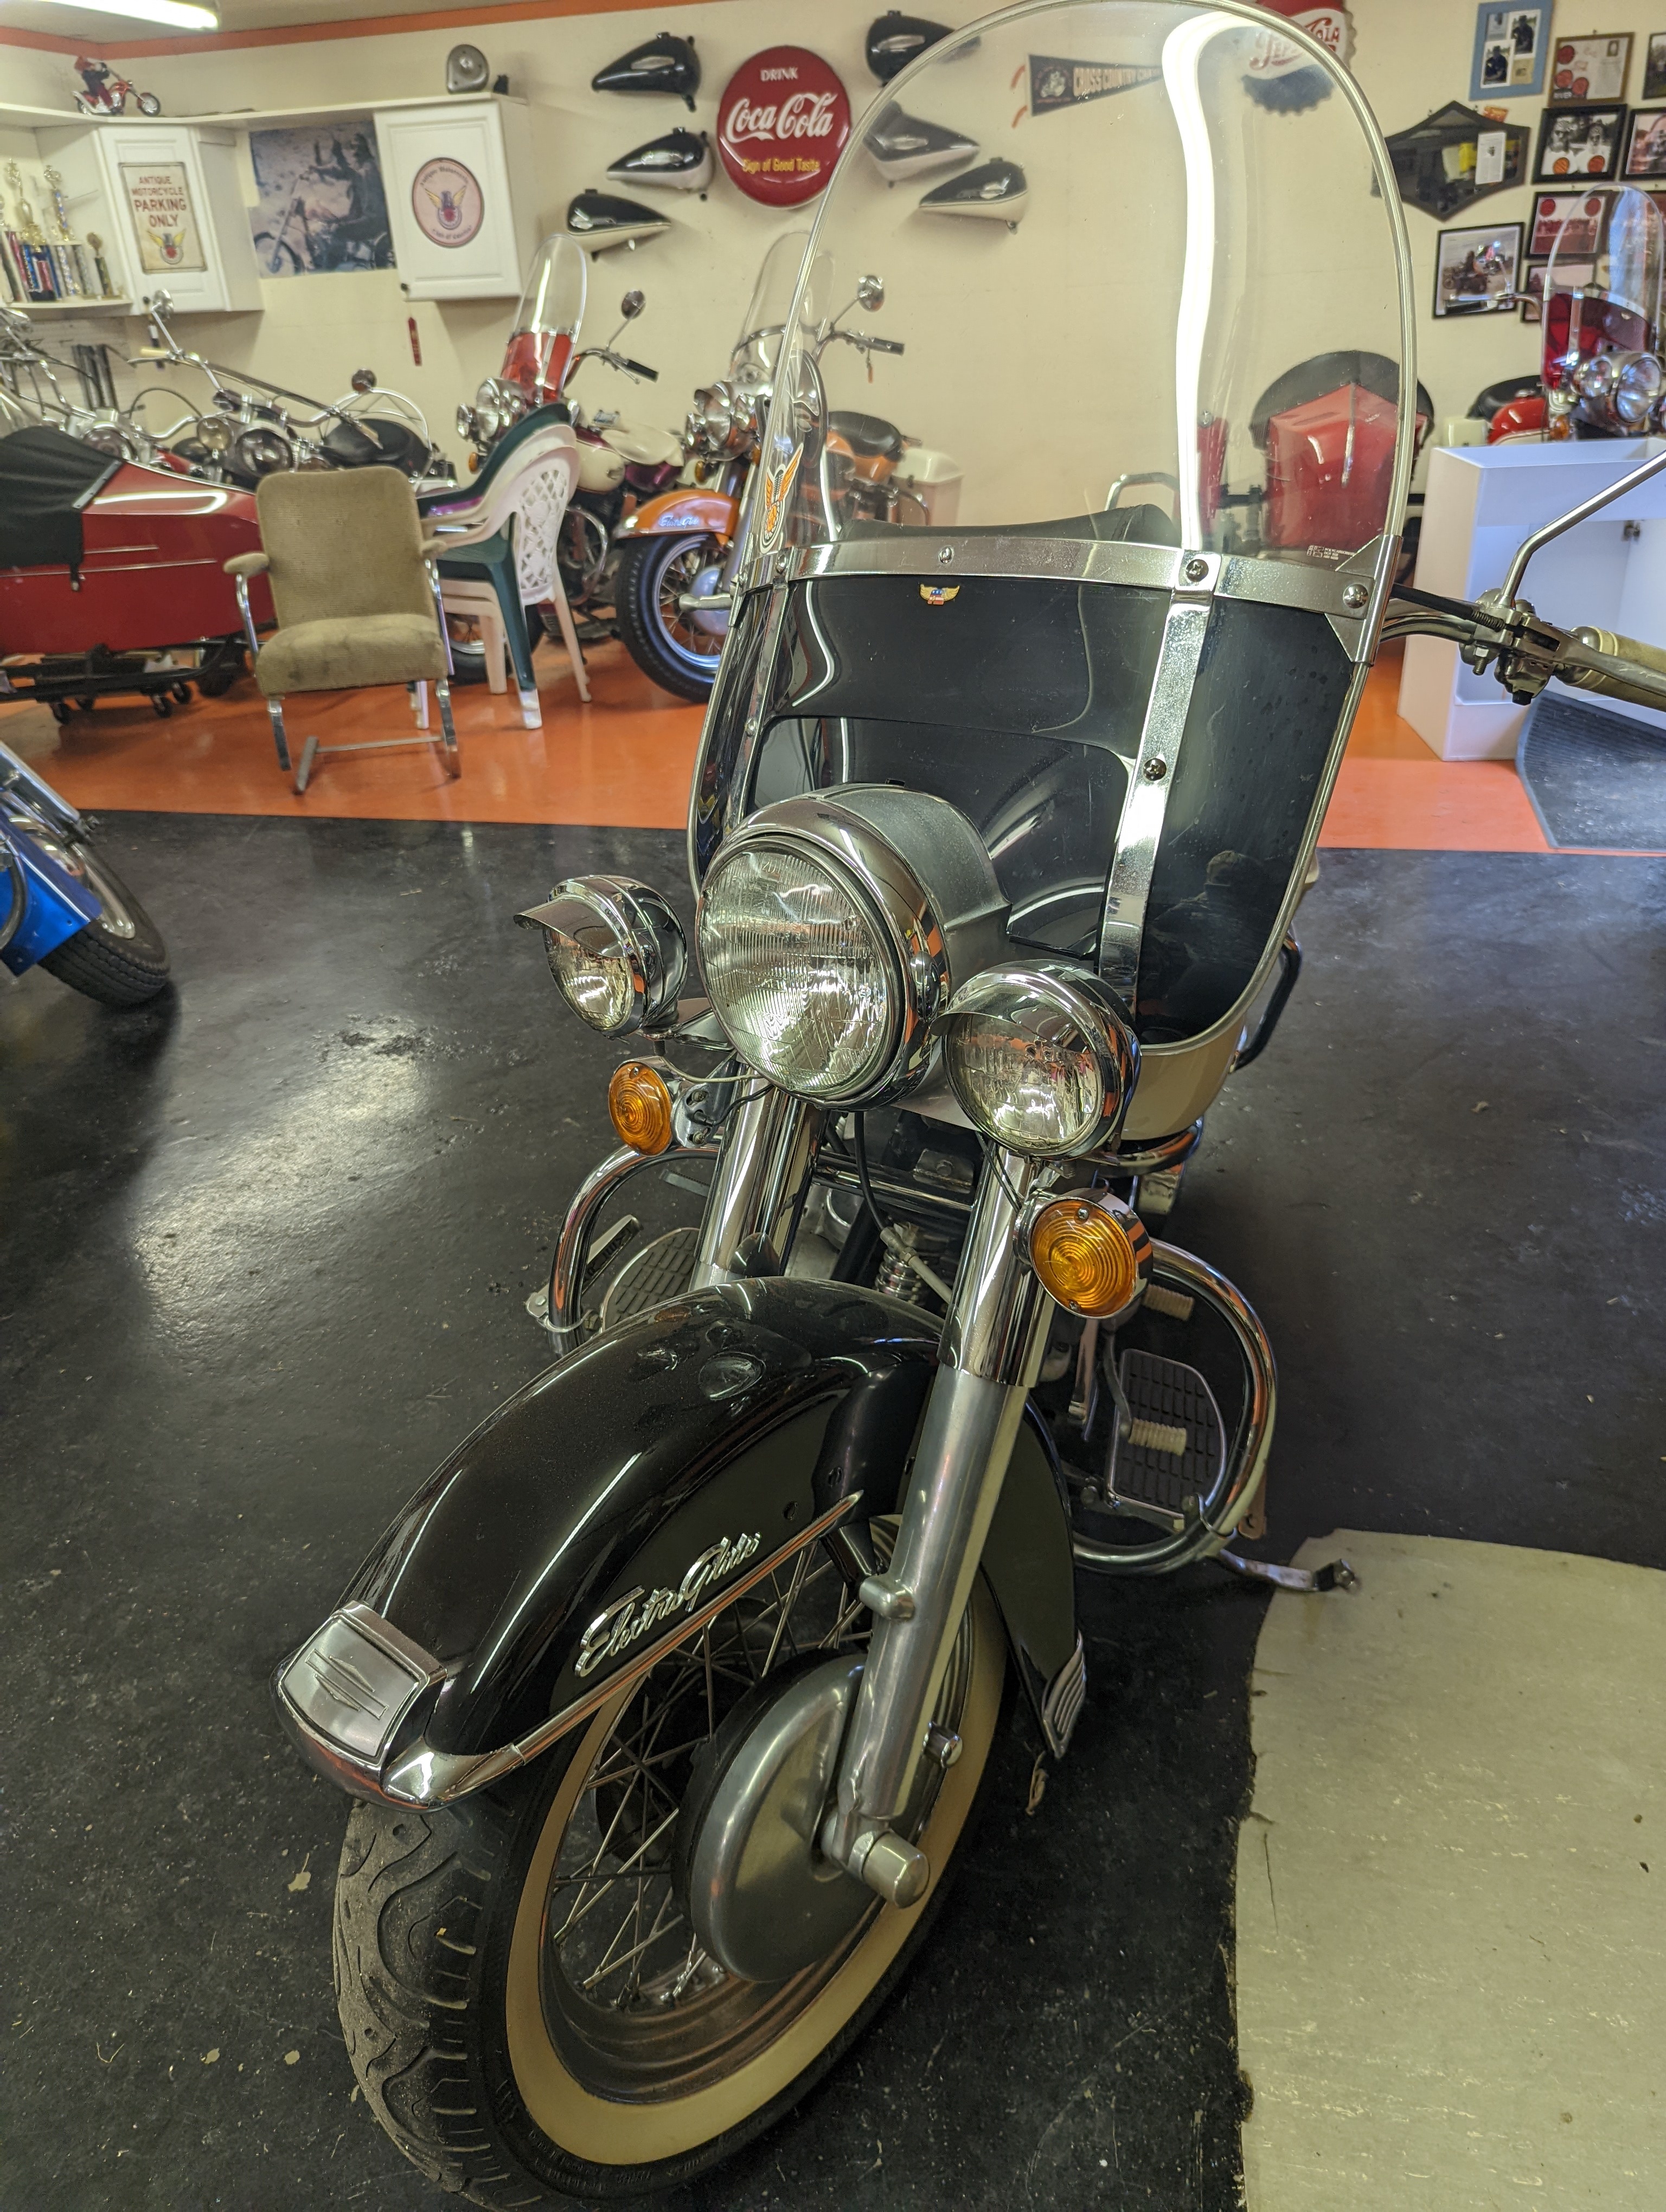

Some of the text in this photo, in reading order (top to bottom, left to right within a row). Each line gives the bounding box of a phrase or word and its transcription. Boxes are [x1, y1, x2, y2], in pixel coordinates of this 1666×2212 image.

[760, 67, 799, 82] DRINK
[1073, 67, 1102, 97] CROSS
[742, 158, 821, 175] Sign of Good Taste
[139, 176, 172, 185] ANTIQUE
[132, 187, 184, 196] MOTORCYCLE
[134, 198, 187, 212] PARKING
[149, 215, 178, 227] ONLY
[574, 1532, 762, 1677] Electra Glide
